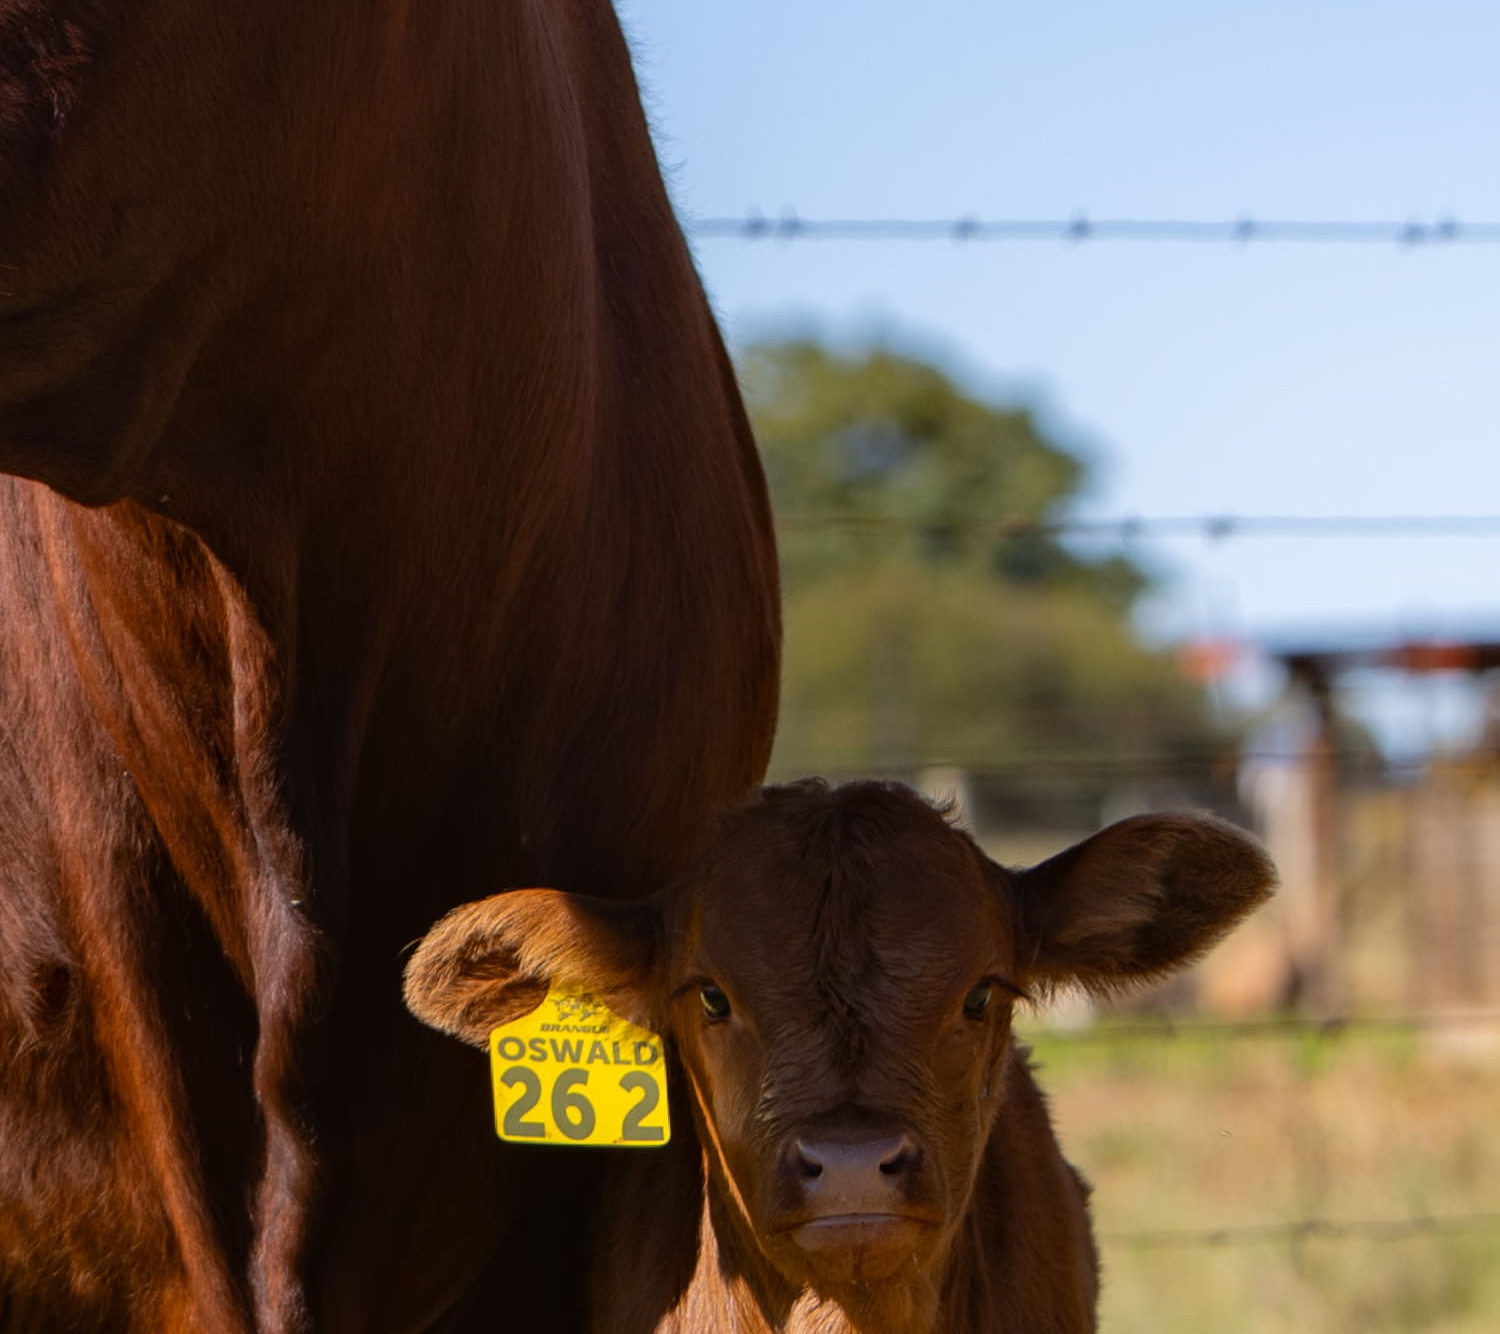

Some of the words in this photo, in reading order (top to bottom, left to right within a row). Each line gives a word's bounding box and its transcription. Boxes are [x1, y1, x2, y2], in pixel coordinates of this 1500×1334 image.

[497, 1036, 659, 1065] OSWALD
[500, 1066, 596, 1140] 26
[618, 1070, 664, 1141] 2
